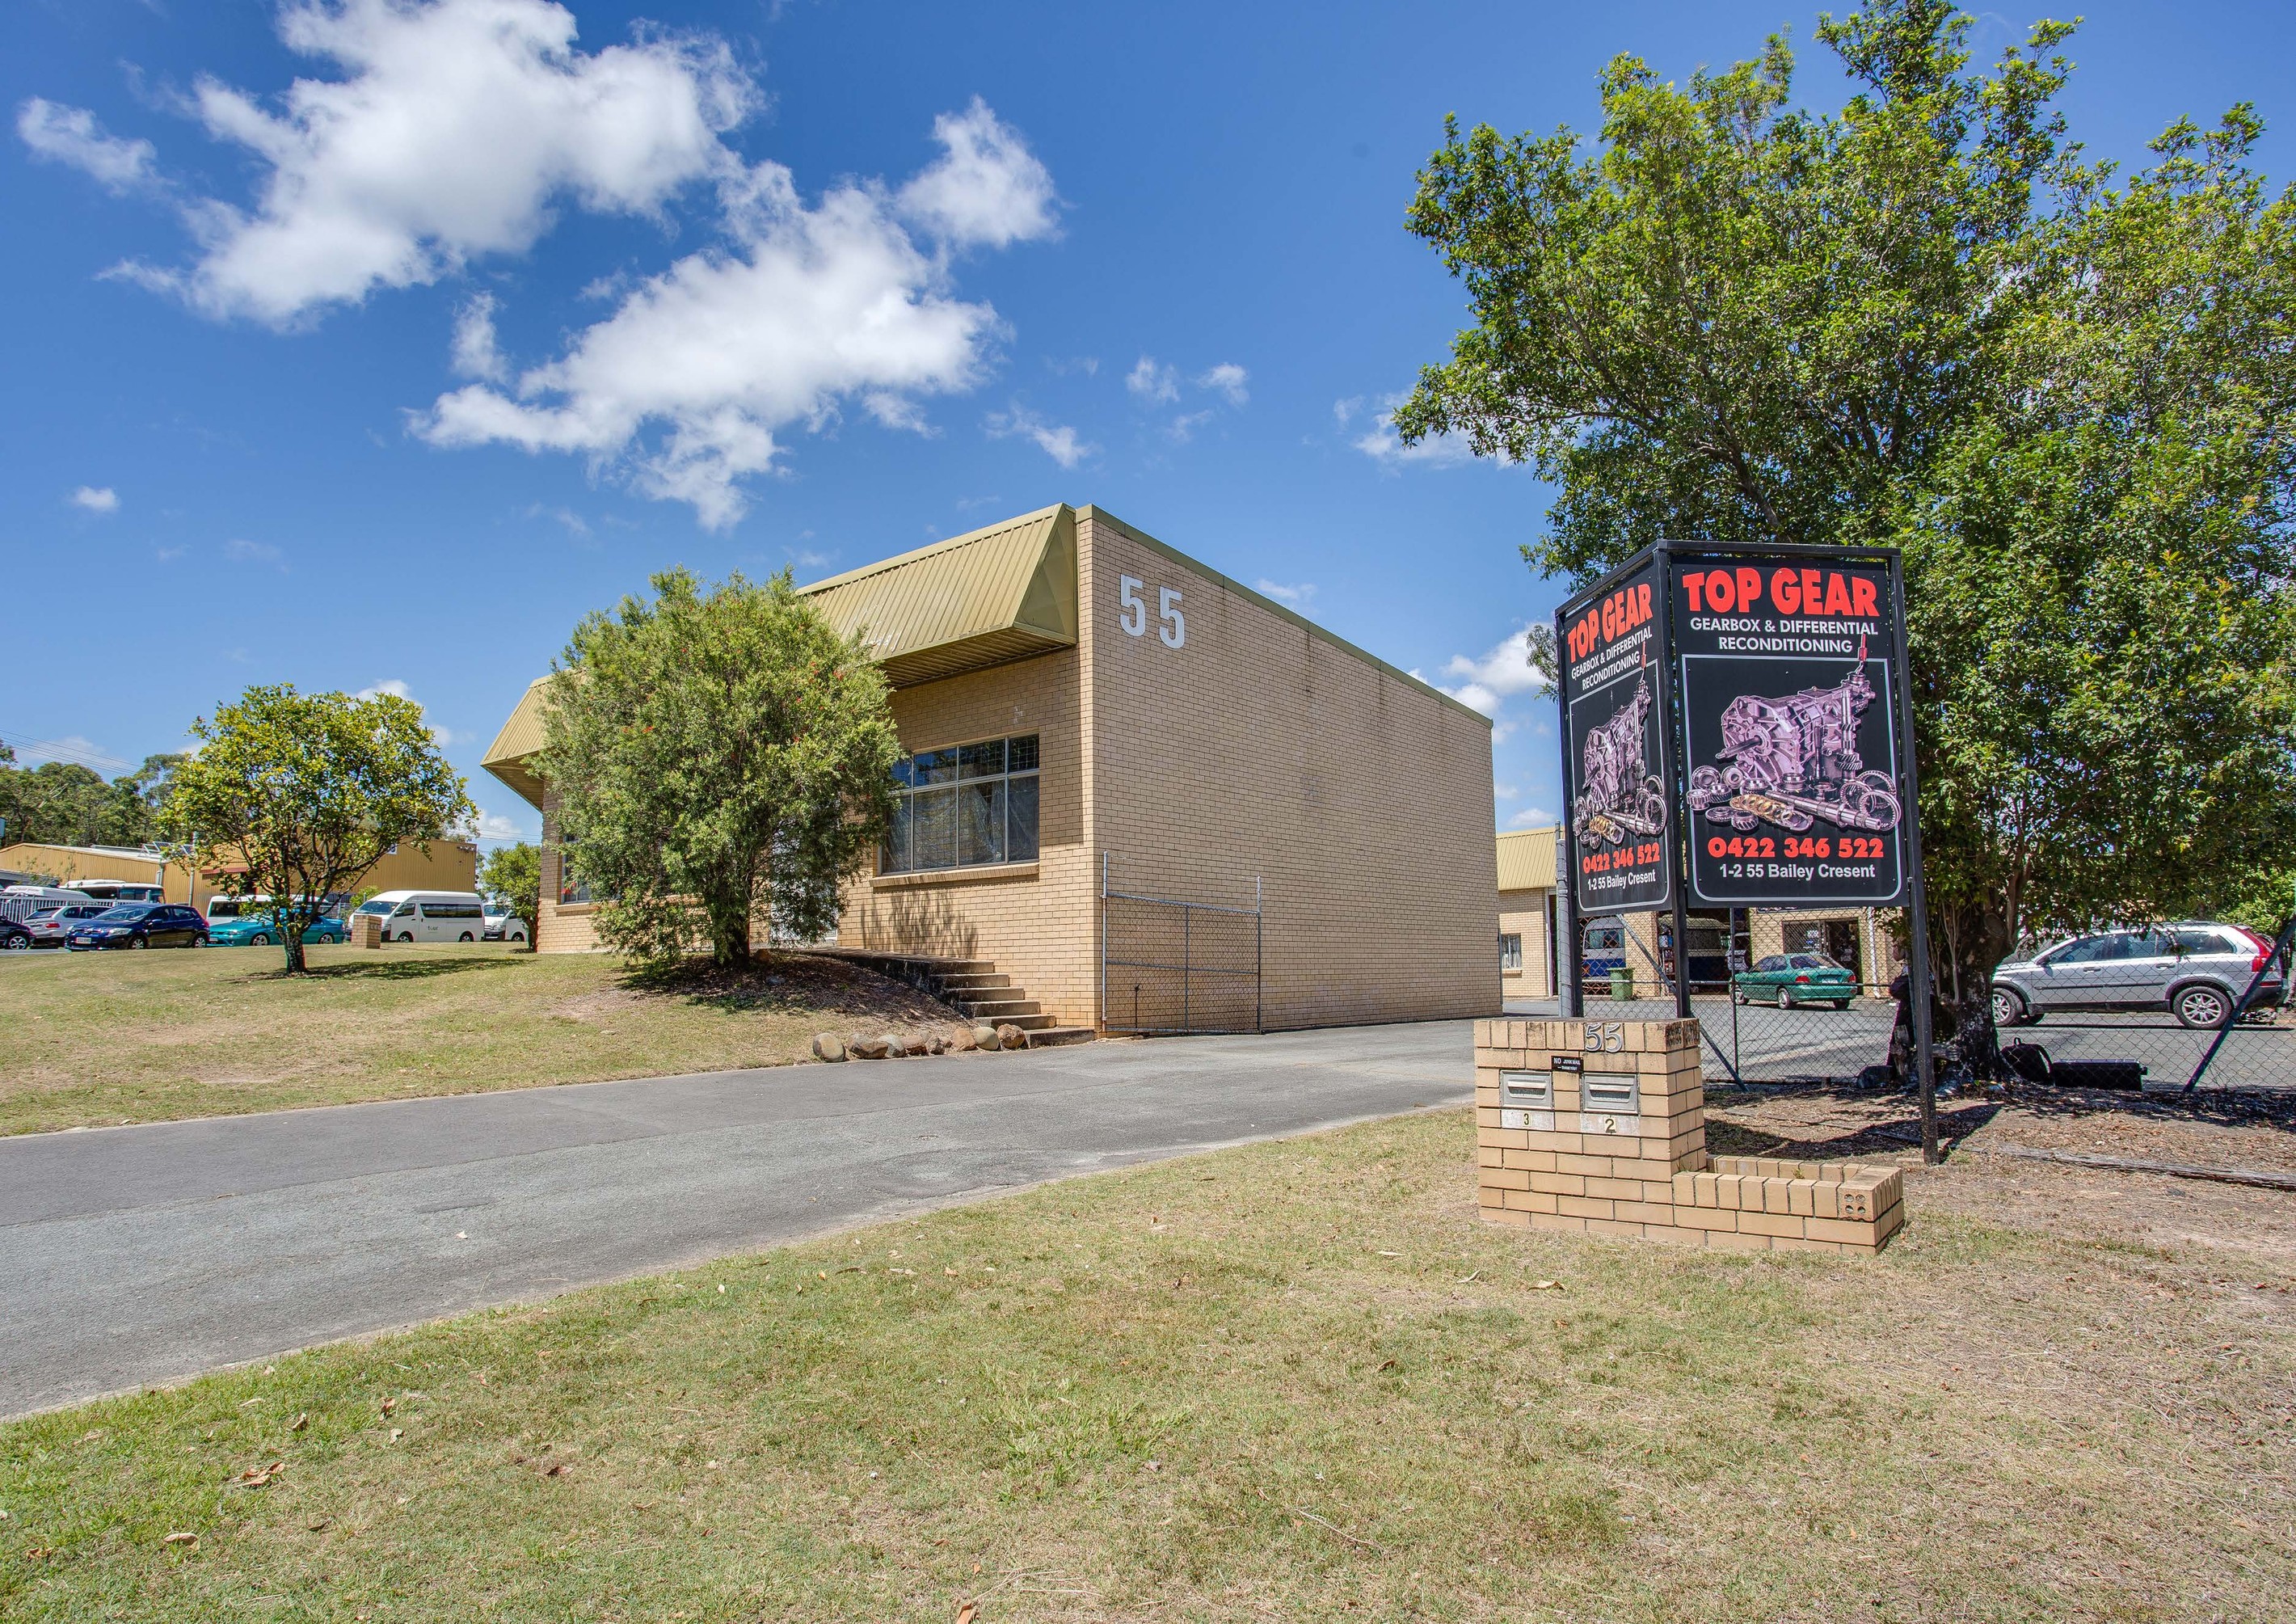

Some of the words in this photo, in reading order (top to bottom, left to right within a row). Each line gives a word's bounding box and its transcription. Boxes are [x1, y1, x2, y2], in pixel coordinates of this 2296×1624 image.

[1683, 567, 1762, 613] TOP
[1770, 568, 1880, 617] GEAR
[1119, 574, 1185, 649] 55
[1568, 608, 1599, 663] TOP
[1602, 584, 1654, 643] GEAR
[1690, 618, 1760, 631] GEARBOX
[1764, 619, 1776, 632] &
[1780, 620, 1878, 635] DIFFERENTIAL
[1571, 655, 1599, 680] GEARBOX
[1600, 652, 1605, 664] &
[1606, 626, 1653, 661] DIFFERENTIAL
[1718, 637, 1852, 652] RECONDITIONING
[1582, 651, 1641, 690] RECONDITIONING
[1582, 852, 1611, 874] 0422
[1612, 846, 1634, 869] 346
[1637, 842, 1661, 865] 522
[1708, 837, 1775, 858] 0422
[1784, 837, 1830, 858] 346
[1839, 837, 1884, 858] 522
[1587, 878, 1598, 891] 1-2
[1598, 876, 1606, 889] 55
[1607, 874, 1627, 889] Bailey
[1628, 869, 1656, 885] Cresent
[1720, 863, 1742, 878] 1-2
[1746, 863, 1764, 878] 55
[1768, 863, 1814, 881] Bailey
[1818, 863, 1876, 878] Cresent
[1585, 1022, 1623, 1053] 55
[1523, 1112, 1530, 1125] 3
[1604, 1118, 1616, 1133] 2
